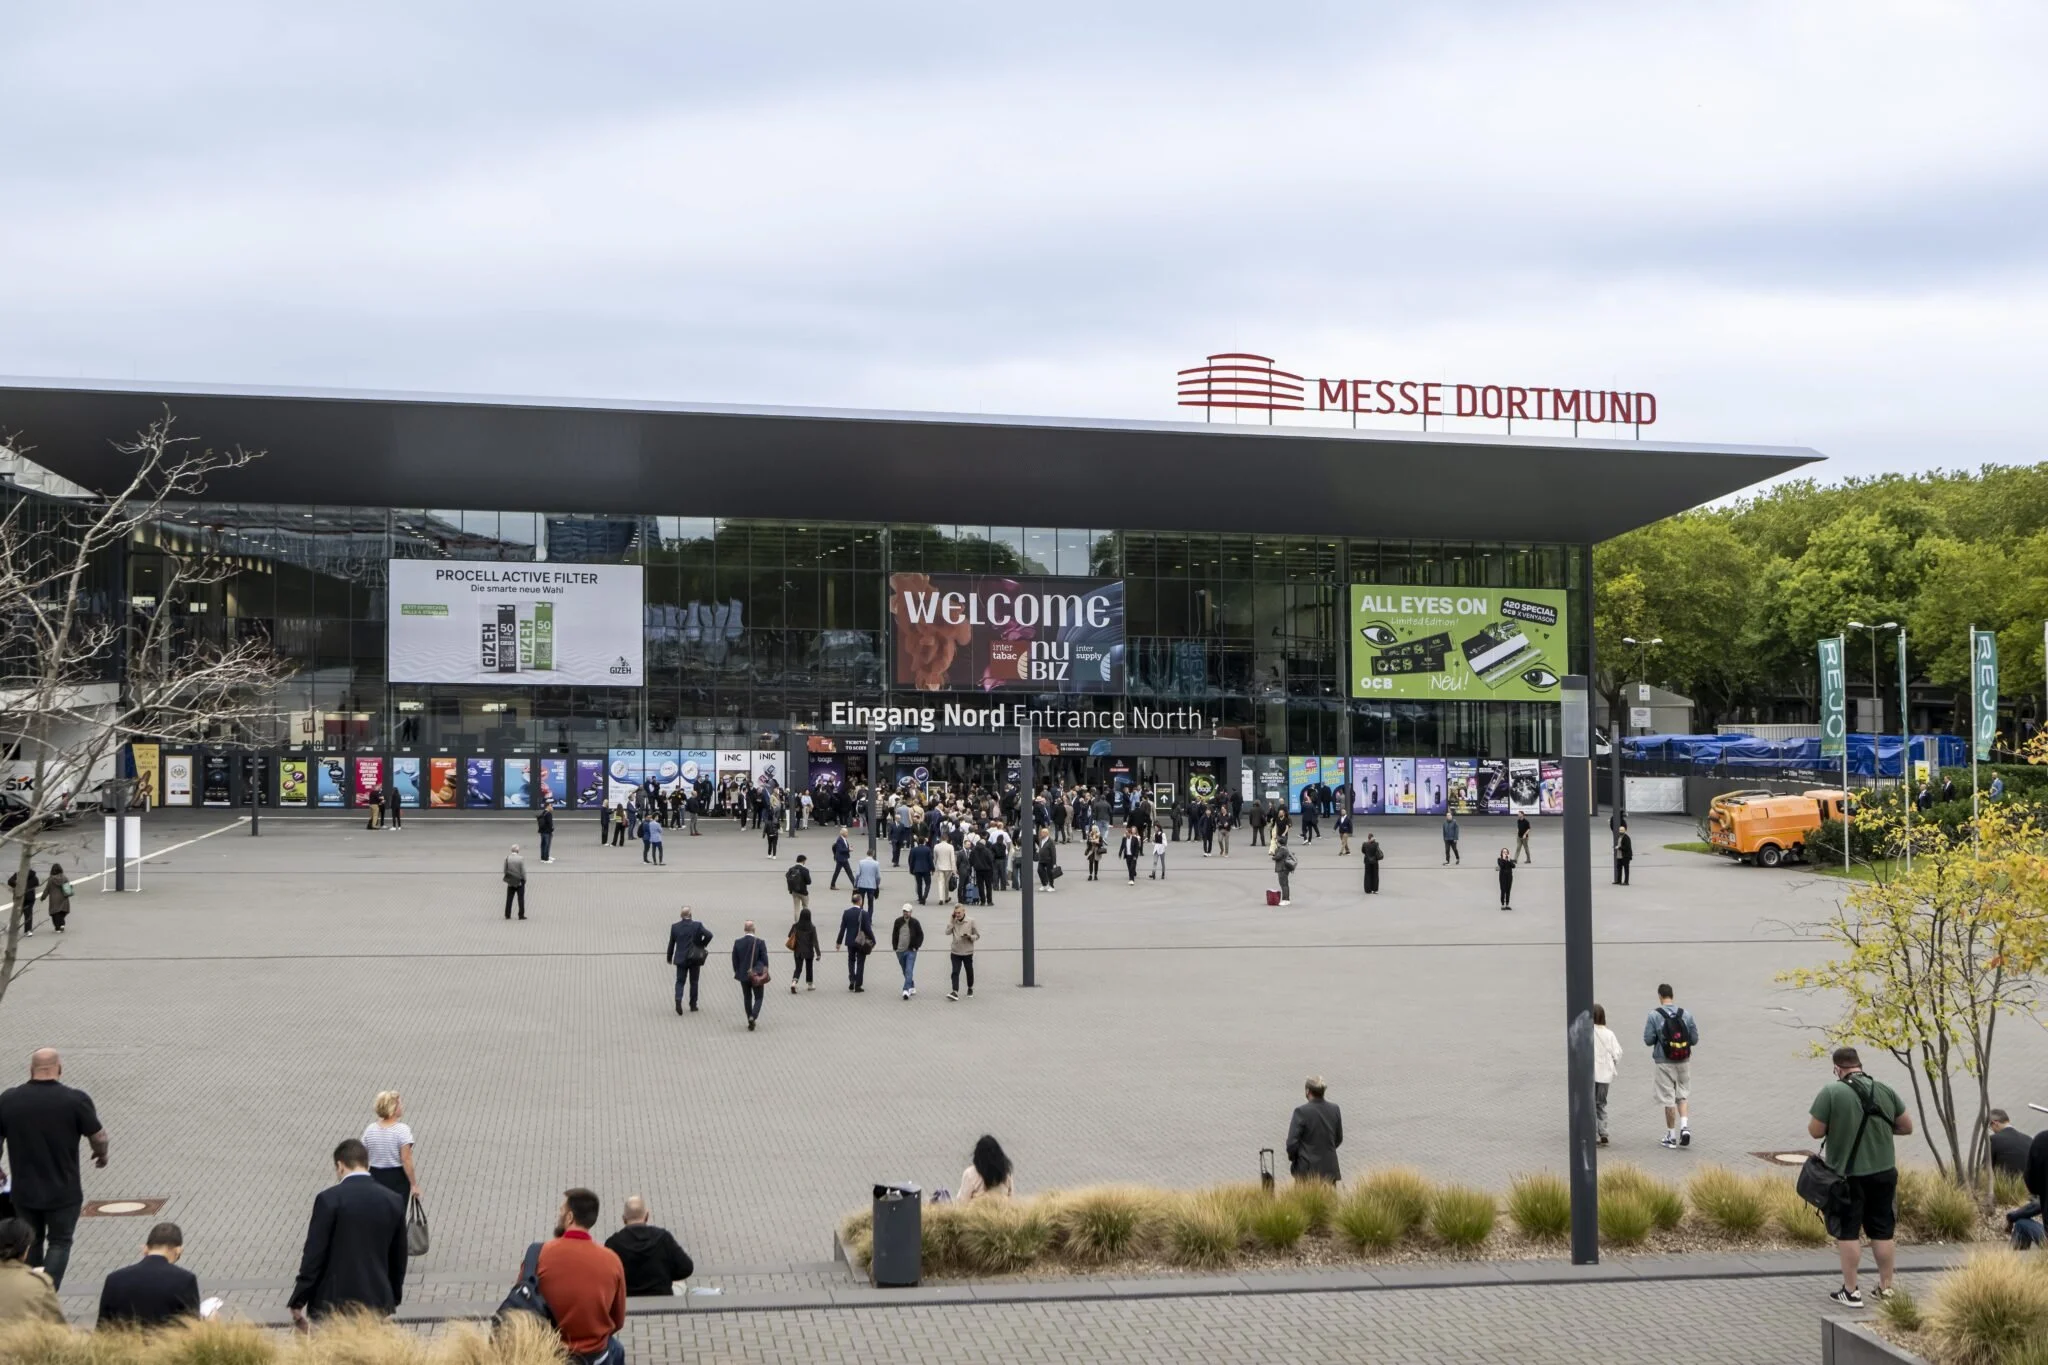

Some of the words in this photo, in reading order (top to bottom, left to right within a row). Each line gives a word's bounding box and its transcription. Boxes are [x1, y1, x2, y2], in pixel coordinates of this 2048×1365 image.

[1319, 378, 1442, 416] MESSE
[1456, 384, 1657, 425] DORTMUND
[436, 569, 499, 583] PROCELL
[502, 571, 550, 584] ACTIVE
[554, 572, 598, 584] FILTER
[471, 584, 485, 593] Die
[486, 585, 517, 593] smarte
[519, 586, 541, 594] neue
[542, 585, 564, 594] Wahl
[1360, 595, 1398, 613] ALL
[1401, 596, 1453, 614] EYES
[1456, 597, 1487, 615] ON
[1503, 600, 1520, 609] 420
[1521, 603, 1556, 617] SPECIAL
[1391, 616, 1425, 626] Limited
[1425, 618, 1460, 627] Edition!
[1502, 608, 1516, 616] OCB
[1522, 612, 1555, 623] VENYASON
[500, 624, 514, 633] 50
[537, 620, 550, 631] 50
[482, 623, 496, 667] GIZEH
[519, 619, 533, 664] GIZEH
[992, 643, 1013, 651] inter
[992, 652, 1017, 660] tabac
[1031, 640, 1069, 660] nu
[1075, 652, 1102, 662] supply
[609, 667, 632, 675] GIZEH
[1031, 661, 1070, 681] BIZ
[1360, 677, 1393, 690] OCB
[1430, 671, 1470, 691] Neu!
[1979, 635, 1996, 740] REJO
[1824, 643, 1844, 738] REJO
[831, 701, 936, 732] Eingang
[944, 703, 1005, 727] Nord
[1013, 704, 1125, 728] Entrance
[1133, 706, 1202, 729] North
